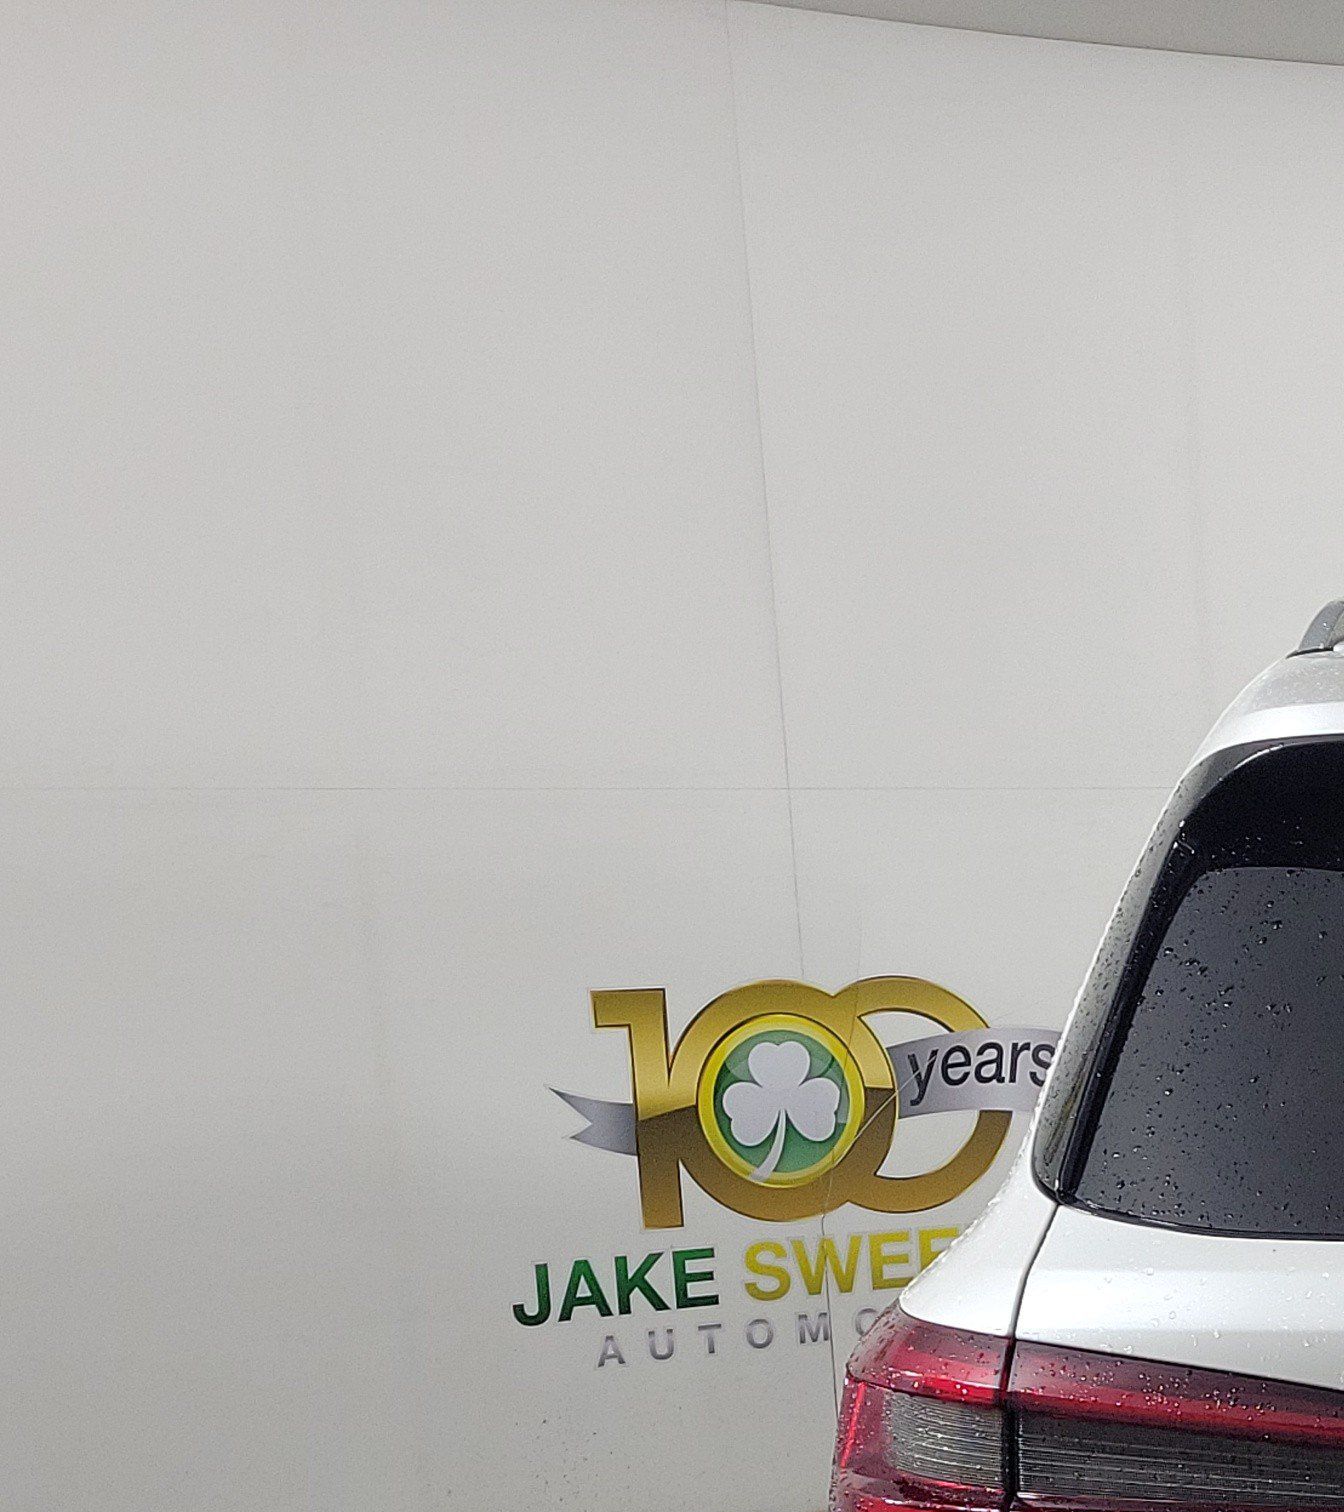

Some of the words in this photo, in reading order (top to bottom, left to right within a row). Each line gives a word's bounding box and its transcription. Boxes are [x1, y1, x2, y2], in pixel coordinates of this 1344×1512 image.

[590, 975, 1014, 1230] 100
[907, 1042, 1056, 1106] years
[512, 1247, 720, 1327] JAKE
[745, 1228, 960, 1301] SWEE
[598, 1307, 883, 1367] AUTOMO
